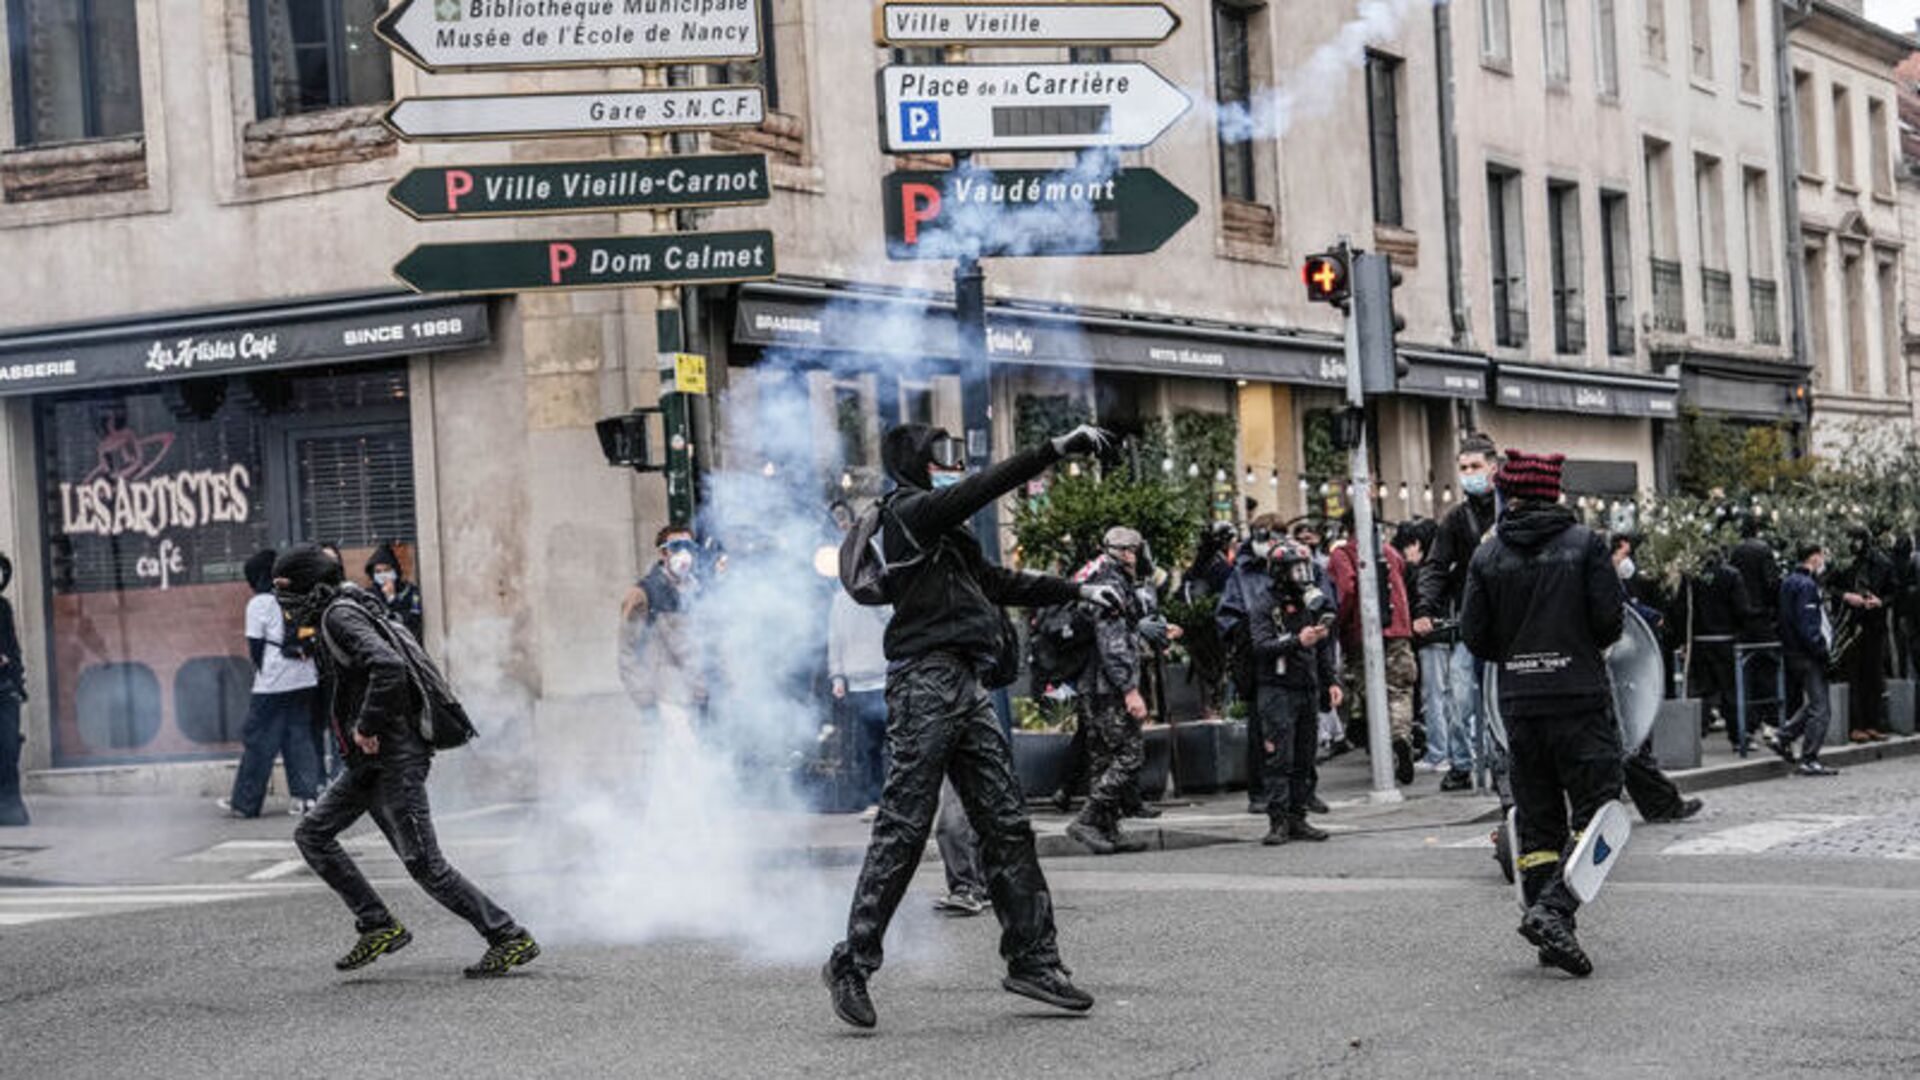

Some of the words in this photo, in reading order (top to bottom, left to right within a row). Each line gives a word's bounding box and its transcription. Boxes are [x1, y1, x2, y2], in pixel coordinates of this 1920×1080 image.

[436, 28, 511, 48] Musée
[522, 26, 549, 46] de
[558, 21, 635, 45] l'École
[645, 24, 672, 42] de
[681, 22, 749, 43] Nancy
[897, 14, 950, 31] Ville
[965, 14, 1040, 31] Vieille
[901, 74, 969, 96] Place
[977, 79, 997, 95] de
[1003, 80, 1019, 94] la
[1025, 72, 1130, 94] Carrière
[590, 102, 647, 121] Gare
[662, 97, 756, 117] S.N.C.F.
[909, 107, 929, 136] P
[445, 170, 474, 210] P
[485, 180, 551, 201] Ville
[562, 170, 759, 197] Vieille-Carnot
[955, 179, 1116, 202] Vaudémont
[902, 183, 942, 244] P
[549, 243, 577, 283] P
[590, 250, 651, 274] Dom
[664, 246, 764, 269] Calmet
[344, 324, 404, 346] SINCE
[60, 474, 113, 536] LES
[135, 538, 183, 590] café
